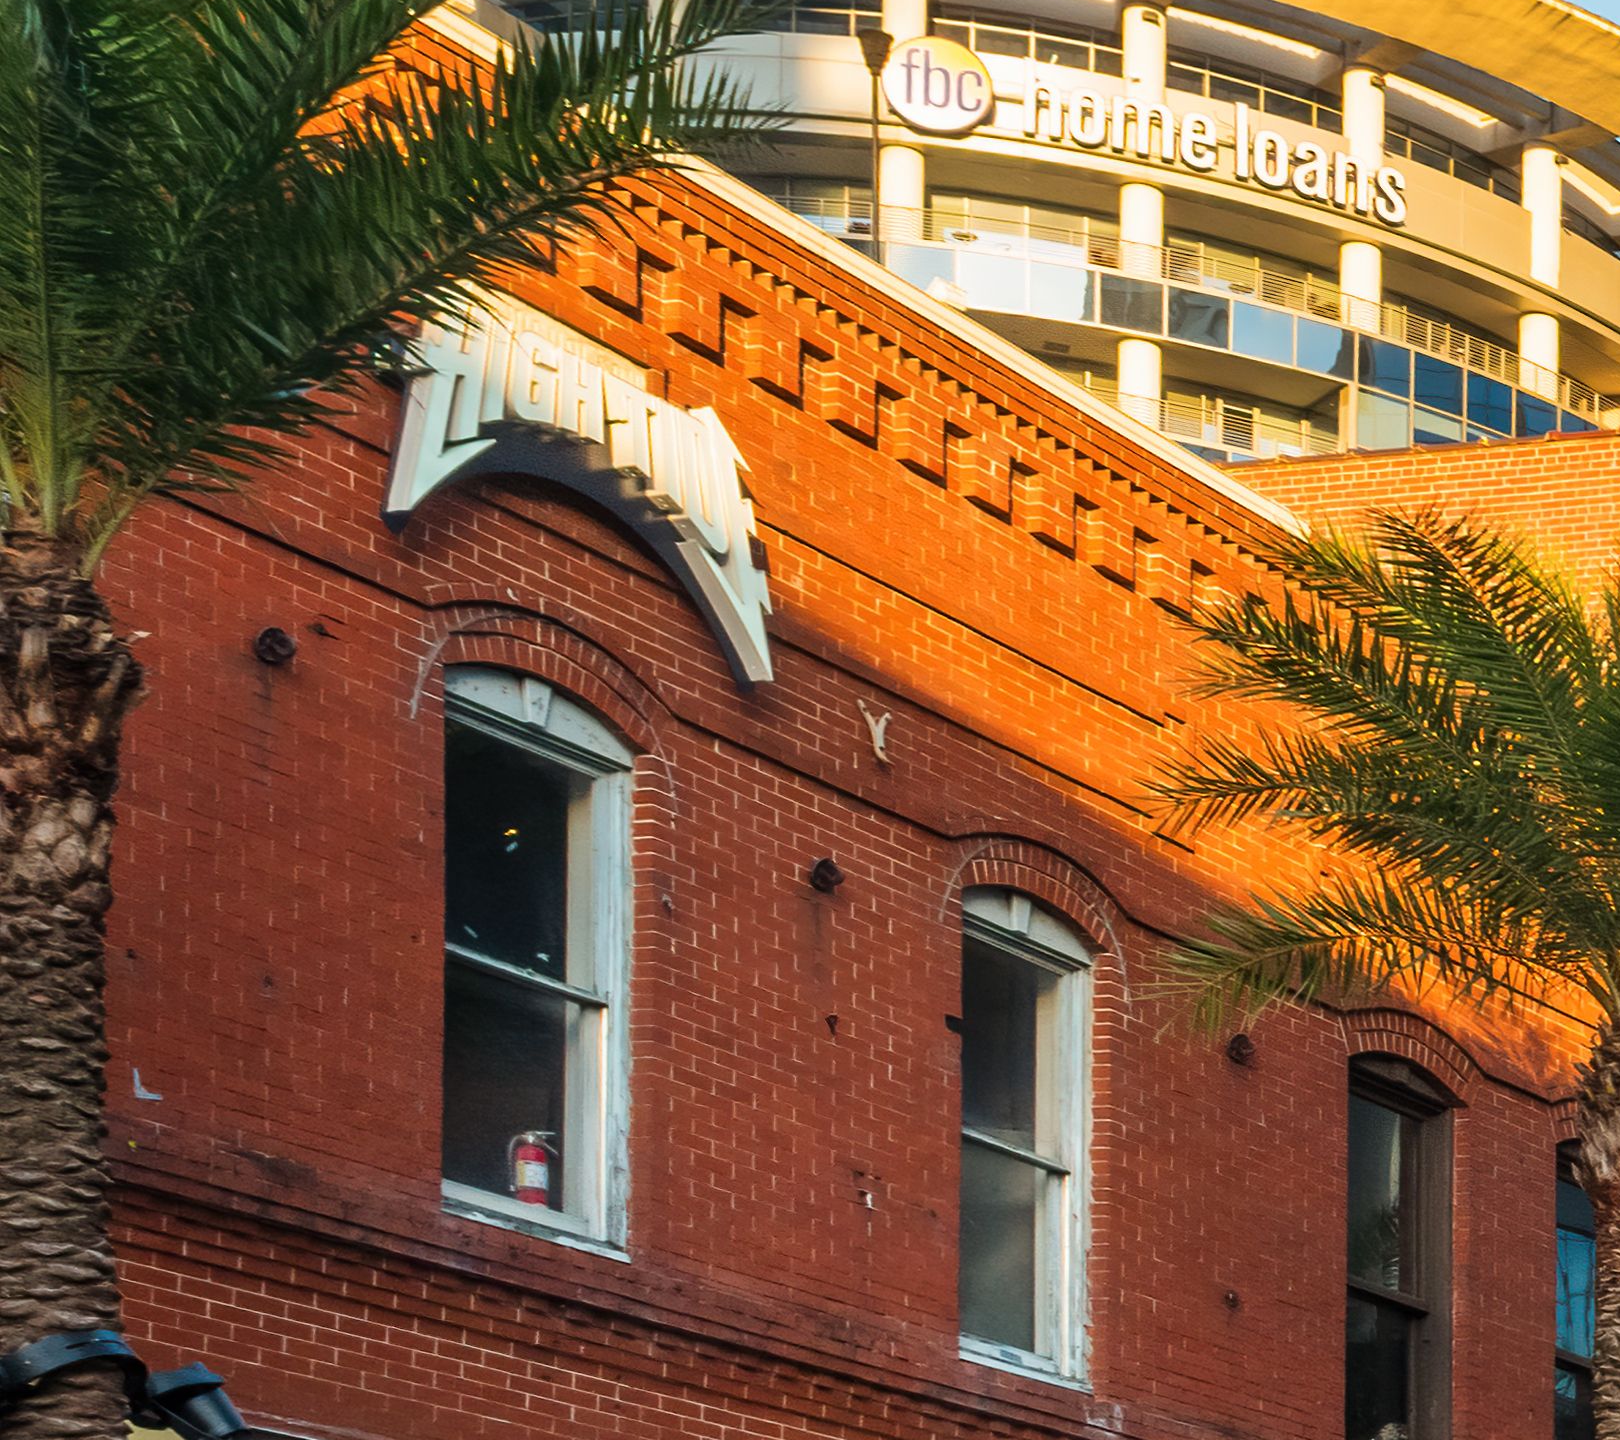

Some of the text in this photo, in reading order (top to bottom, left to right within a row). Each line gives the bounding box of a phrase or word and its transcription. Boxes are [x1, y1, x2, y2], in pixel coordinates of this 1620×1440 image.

[899, 46, 983, 112] fbc
[1023, 76, 1408, 226] home loans
